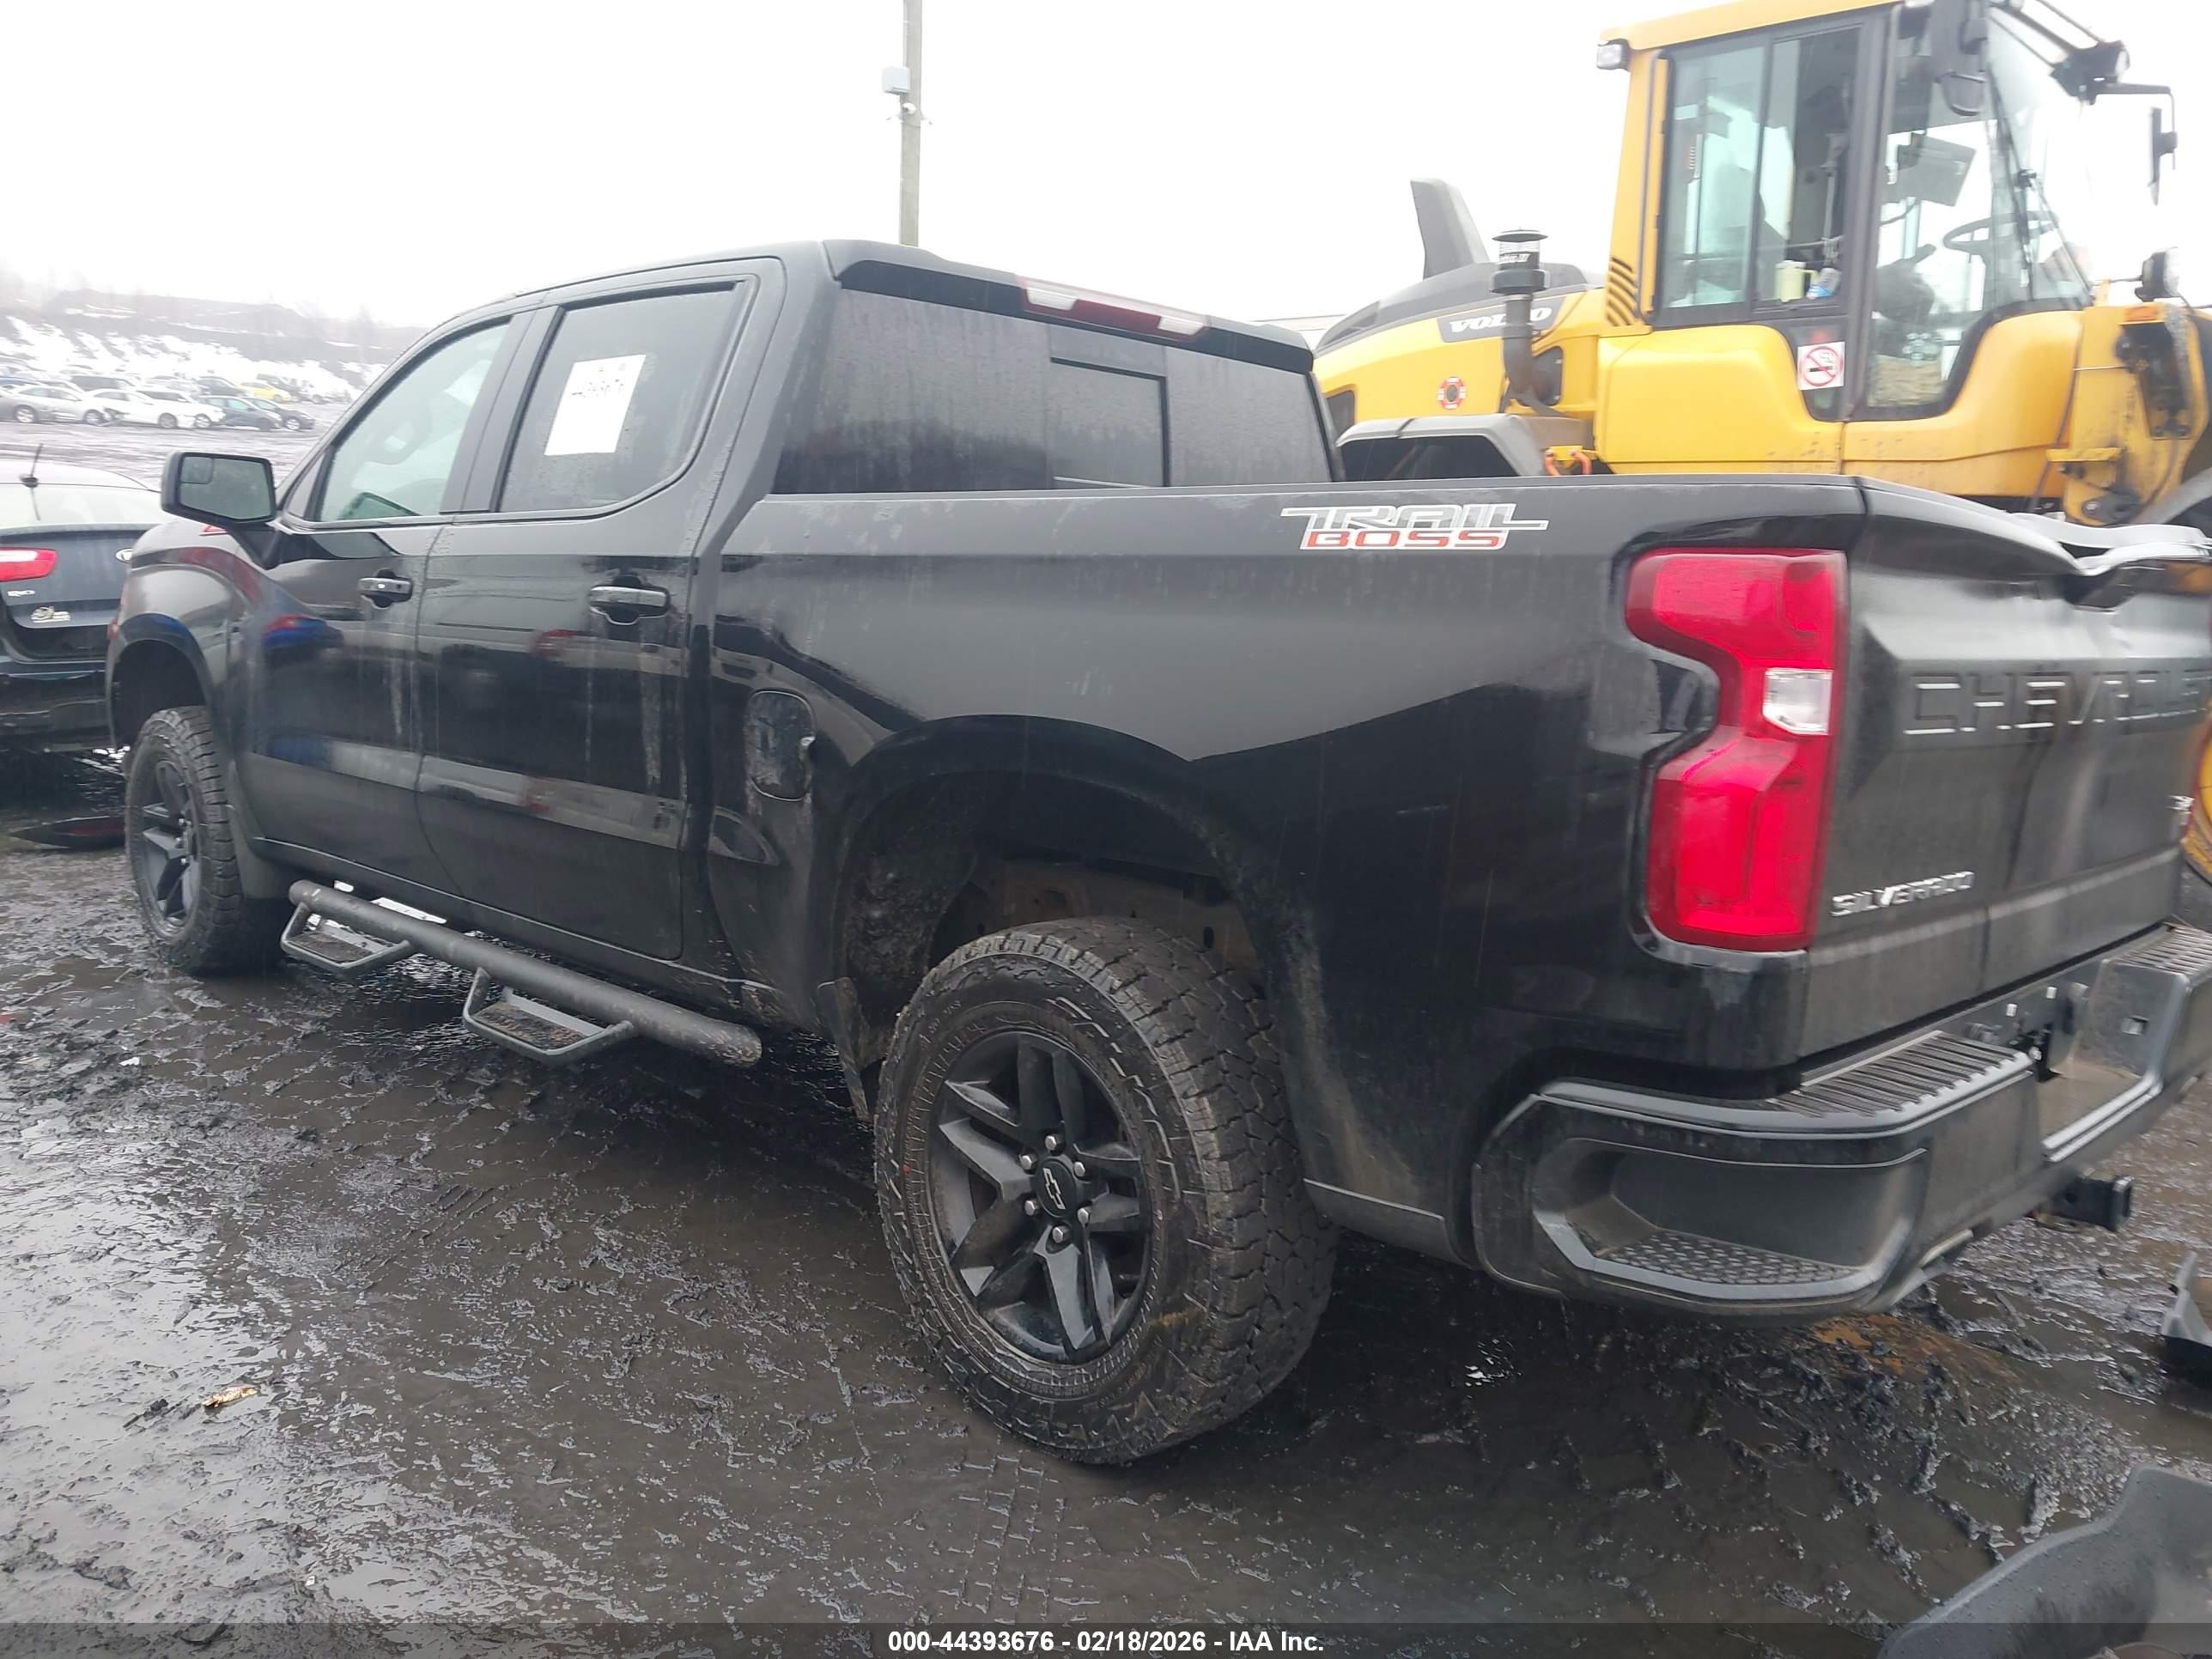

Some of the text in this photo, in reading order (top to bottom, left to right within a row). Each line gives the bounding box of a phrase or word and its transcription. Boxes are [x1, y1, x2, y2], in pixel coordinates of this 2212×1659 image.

[1449, 307, 1552, 333] VOLO
[1280, 504, 1549, 530] TRAIL
[1301, 529, 1509, 550] BOSS
[1831, 870, 1975, 916] SILVERADO
